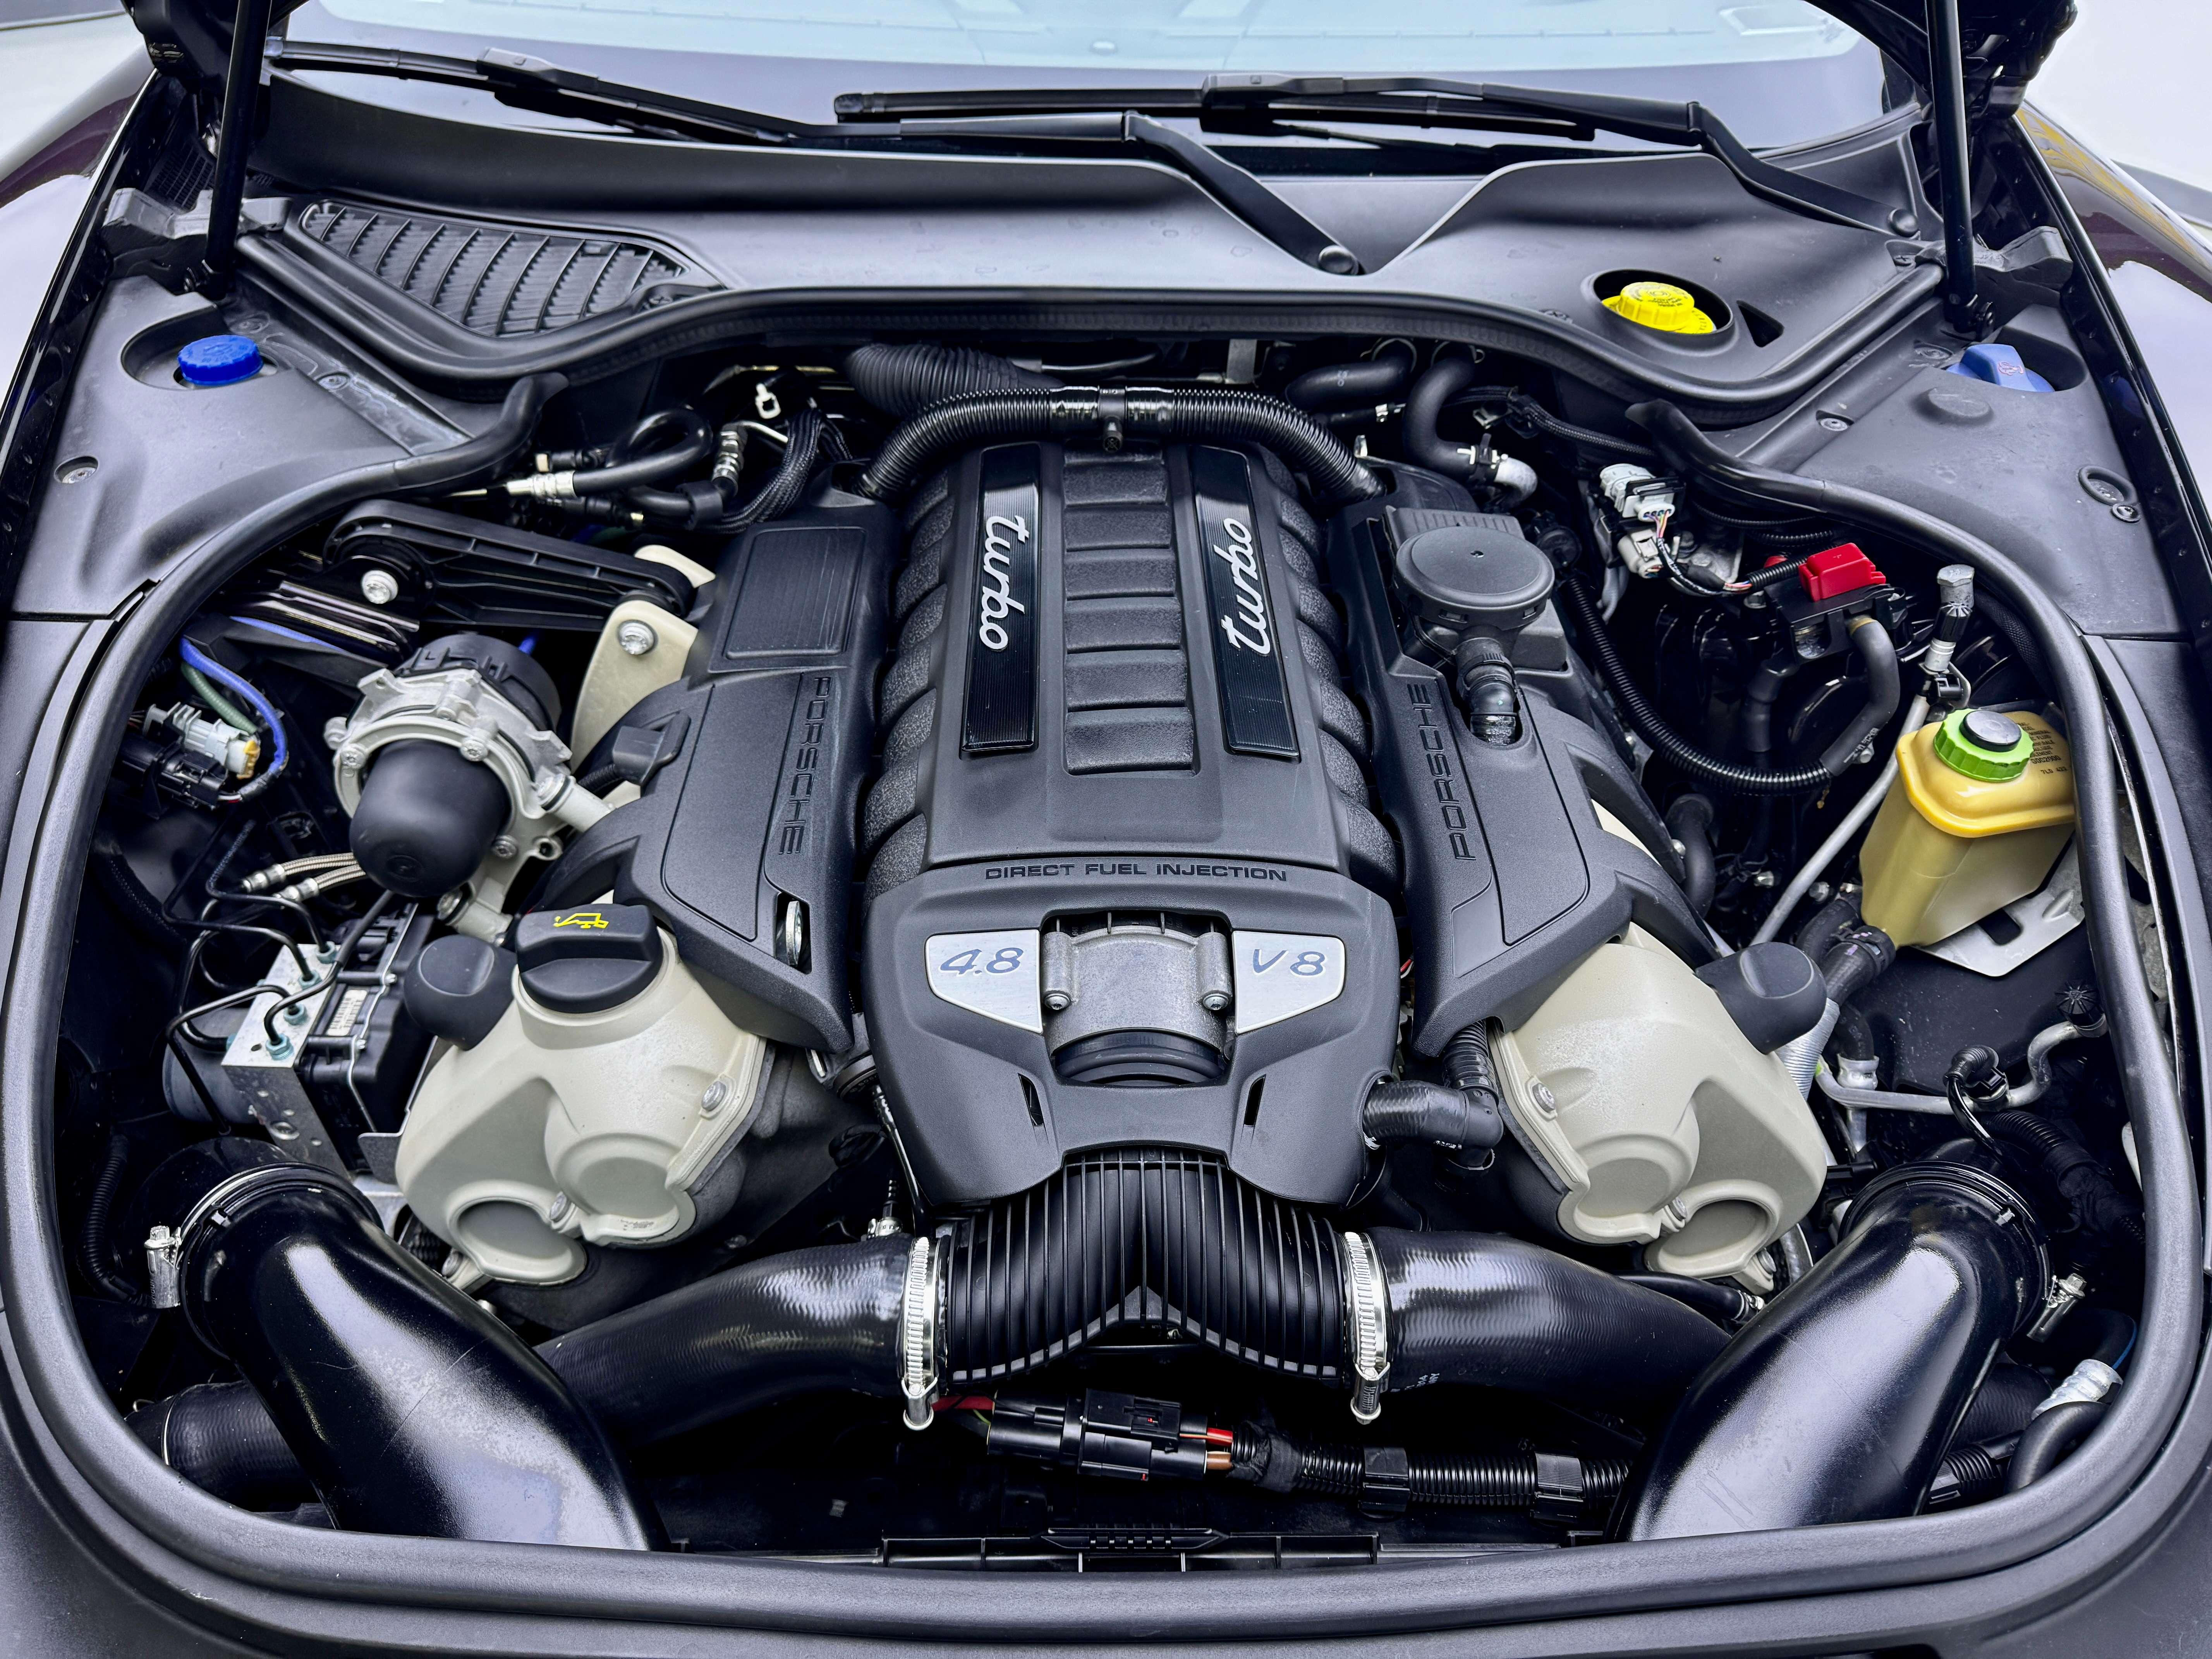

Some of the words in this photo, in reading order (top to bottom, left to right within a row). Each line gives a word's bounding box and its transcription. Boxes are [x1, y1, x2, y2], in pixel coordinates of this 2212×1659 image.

[980, 515, 1029, 652] turbo
[1213, 518, 1271, 656] turbo
[778, 677, 832, 855] PORSCHE
[1407, 684, 1476, 860] PORSCHE
[985, 864, 1075, 880] DIRECT
[1085, 863, 1147, 876] FUEL
[1156, 863, 1287, 881] INJECTION
[938, 946, 1024, 977] 4.8
